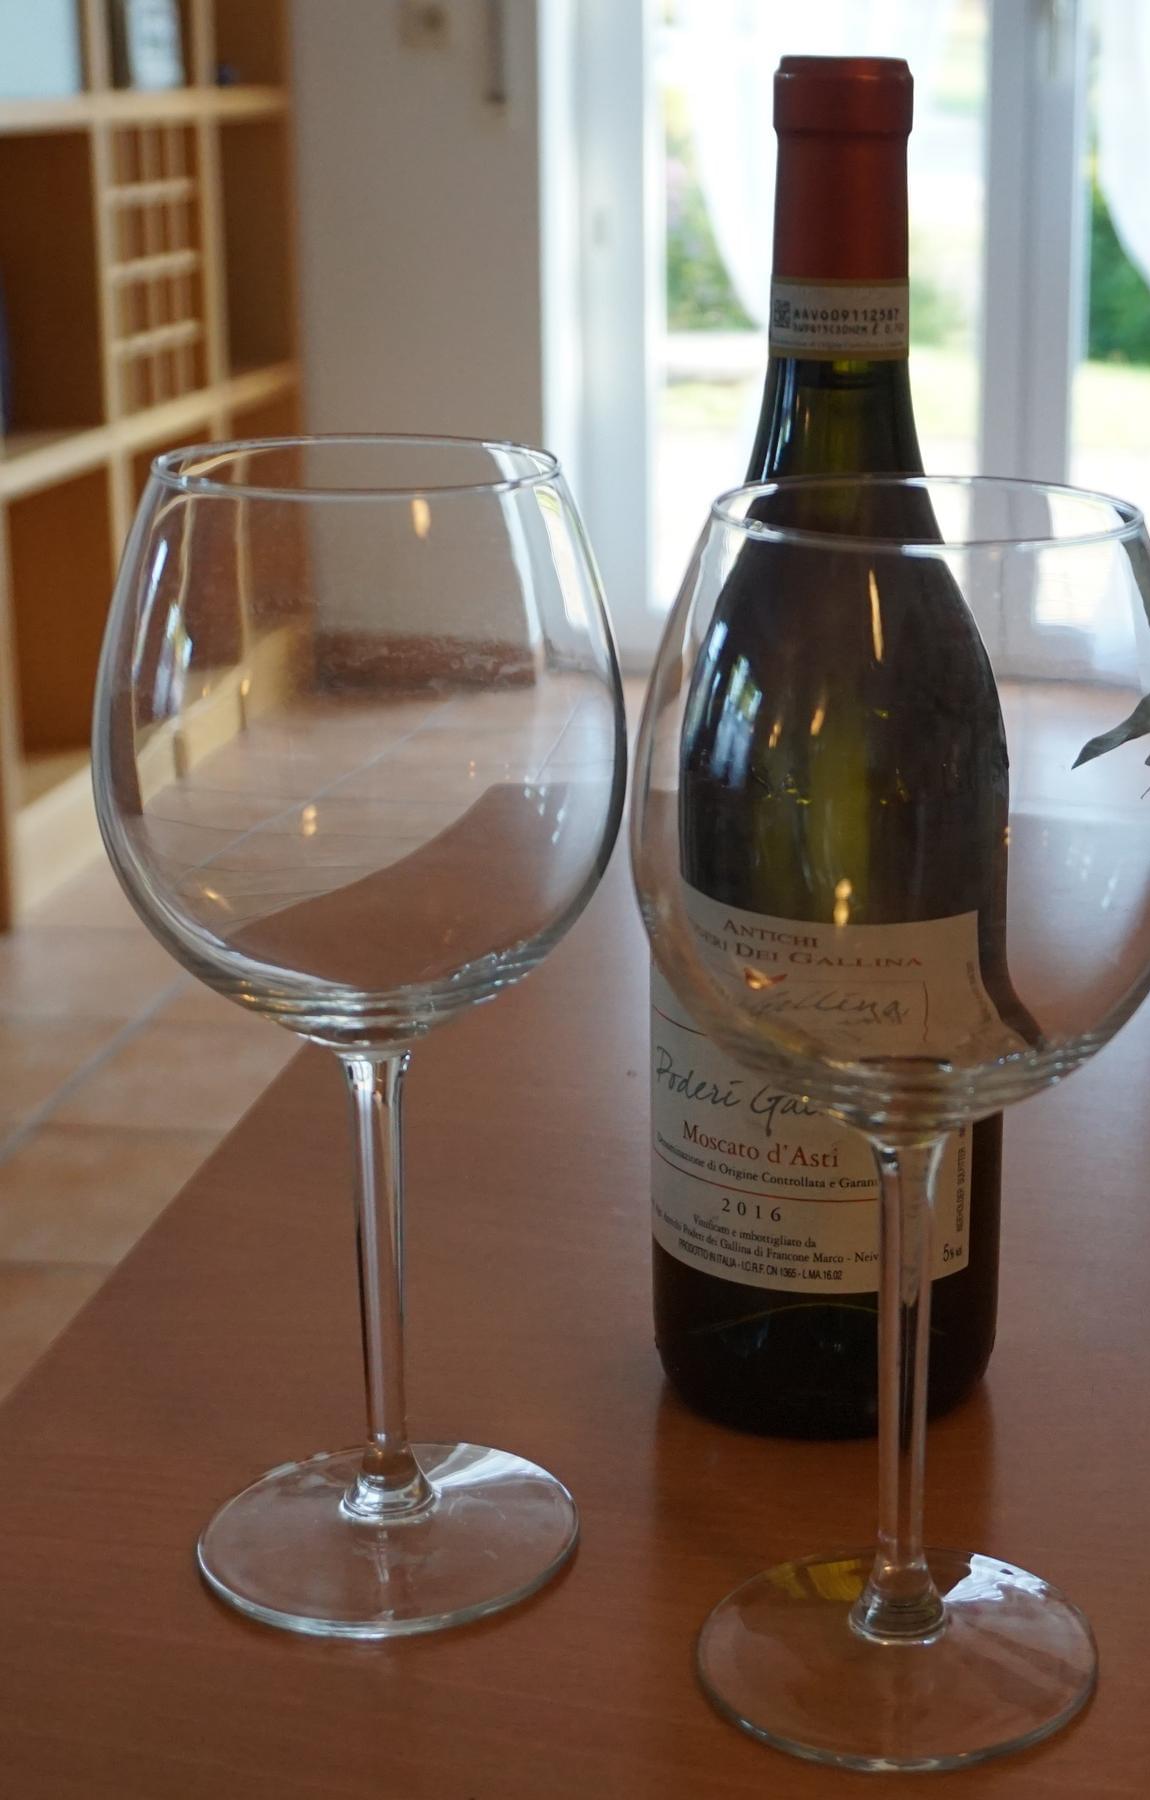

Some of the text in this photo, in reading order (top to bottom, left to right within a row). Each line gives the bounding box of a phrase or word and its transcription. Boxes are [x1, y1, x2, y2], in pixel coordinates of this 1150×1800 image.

[723, 918, 819, 948] ANTICHI
[788, 952, 923, 967] GALLINA
[656, 1045, 743, 1107] Poderi
[682, 1120, 839, 1168] Moscato d'Asti
[707, 1160, 717, 1172] di
[719, 1163, 758, 1182] Origine
[761, 1172, 826, 1188] Controllata
[829, 1180, 837, 1188] e
[721, 1198, 782, 1222] 2016
[719, 1238, 752, 1255] Gallina
[754, 1246, 764, 1257] di
[766, 1248, 810, 1263] Francone
[812, 1252, 844, 1263] Marco
[739, 1231, 802, 1248] imbottigliato
[805, 1236, 817, 1248] da
